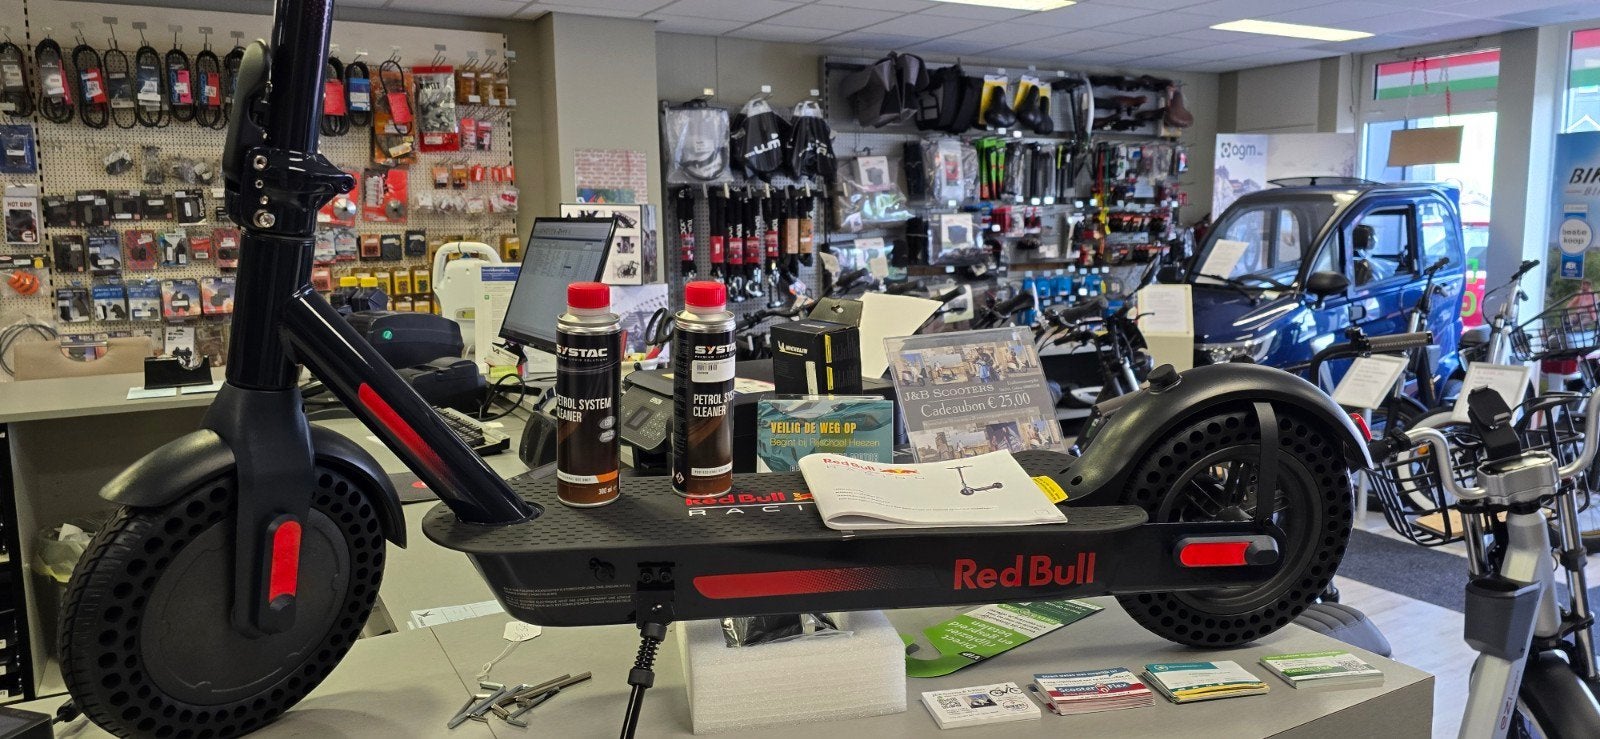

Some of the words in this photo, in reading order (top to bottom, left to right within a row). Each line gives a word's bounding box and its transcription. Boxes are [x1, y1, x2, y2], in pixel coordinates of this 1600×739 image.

[1232, 144, 1256, 160] agm
[1563, 236, 1585, 245] koop
[556, 344, 608, 358] SYSTAC
[694, 341, 737, 355] SYSTA
[693, 393, 723, 405] PETROL
[904, 390, 930, 402] J&B
[933, 384, 995, 398] SCOOTERS
[578, 397, 612, 411] SYSTEM
[921, 399, 986, 418] Cadeaubon
[987, 396, 998, 409] €
[557, 406, 582, 423] LEANER
[693, 405, 726, 418] CLEANER
[771, 421, 801, 434] VEILIG
[804, 421, 816, 434] DE
[820, 421, 840, 434] WEG
[844, 421, 857, 434] OP
[769, 438, 796, 448] Begint
[796, 438, 807, 448] bij
[809, 438, 847, 448] Rijschool
[849, 438, 880, 447] Heezen
[823, 458, 850, 466] Red
[851, 462, 876, 472] Bull
[686, 494, 735, 506] Red
[738, 490, 786, 504] Bull
[688, 504, 804, 517] RACI
[953, 554, 1024, 590] Red
[1028, 552, 1096, 586] Bull
[948, 620, 999, 643] gespreid
[971, 620, 1014, 638] betalen
[941, 634, 978, 650] Direct
[944, 628, 997, 648] rijplezier
[999, 636, 1014, 646] en
[1108, 682, 1128, 690] Flex
